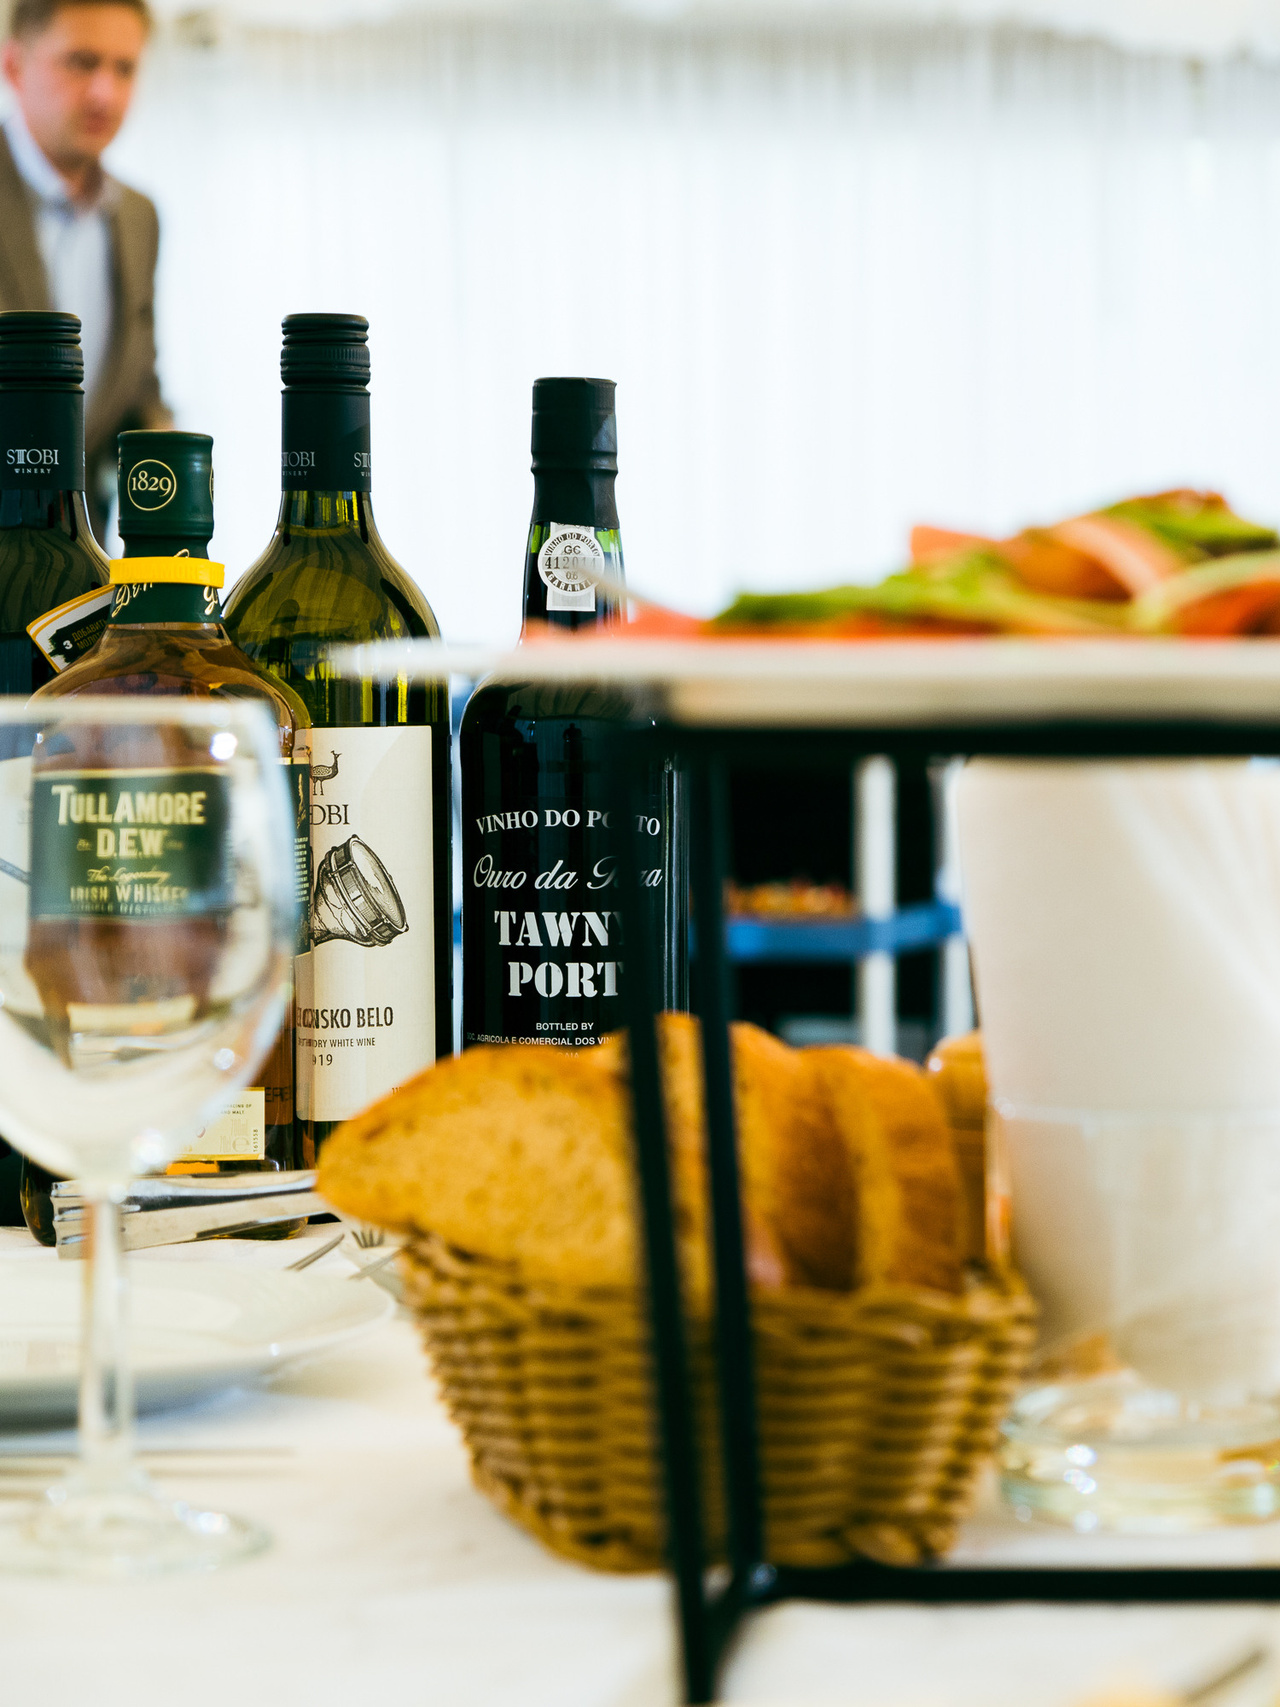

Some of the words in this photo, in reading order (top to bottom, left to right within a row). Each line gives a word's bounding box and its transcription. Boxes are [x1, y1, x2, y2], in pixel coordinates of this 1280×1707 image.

[6, 448, 60, 466] STOBI
[131, 470, 172, 498] 1829
[563, 545, 581, 555] GC
[547, 574, 592, 592] GARANTI
[62, 639, 73, 650] 3
[51, 784, 207, 826] TULLAMORE
[476, 809, 539, 835] VINHO
[544, 809, 581, 828] DO
[473, 853, 528, 890] Ouro
[534, 859, 579, 890] da
[70, 886, 108, 902] IRISH
[508, 961, 624, 998] PORT
[356, 1006, 393, 1028] BELO
[536, 1022, 578, 1031] BOTTLED
[581, 1022, 594, 1031] BY
[330, 1038, 354, 1048] WHITE
[357, 1037, 376, 1047] WINE
[476, 1033, 510, 1044] AGRICOLA
[511, 1036, 517, 1044] E
[518, 1036, 573, 1046] COMERCIAL
[575, 1036, 596, 1046] DOS
